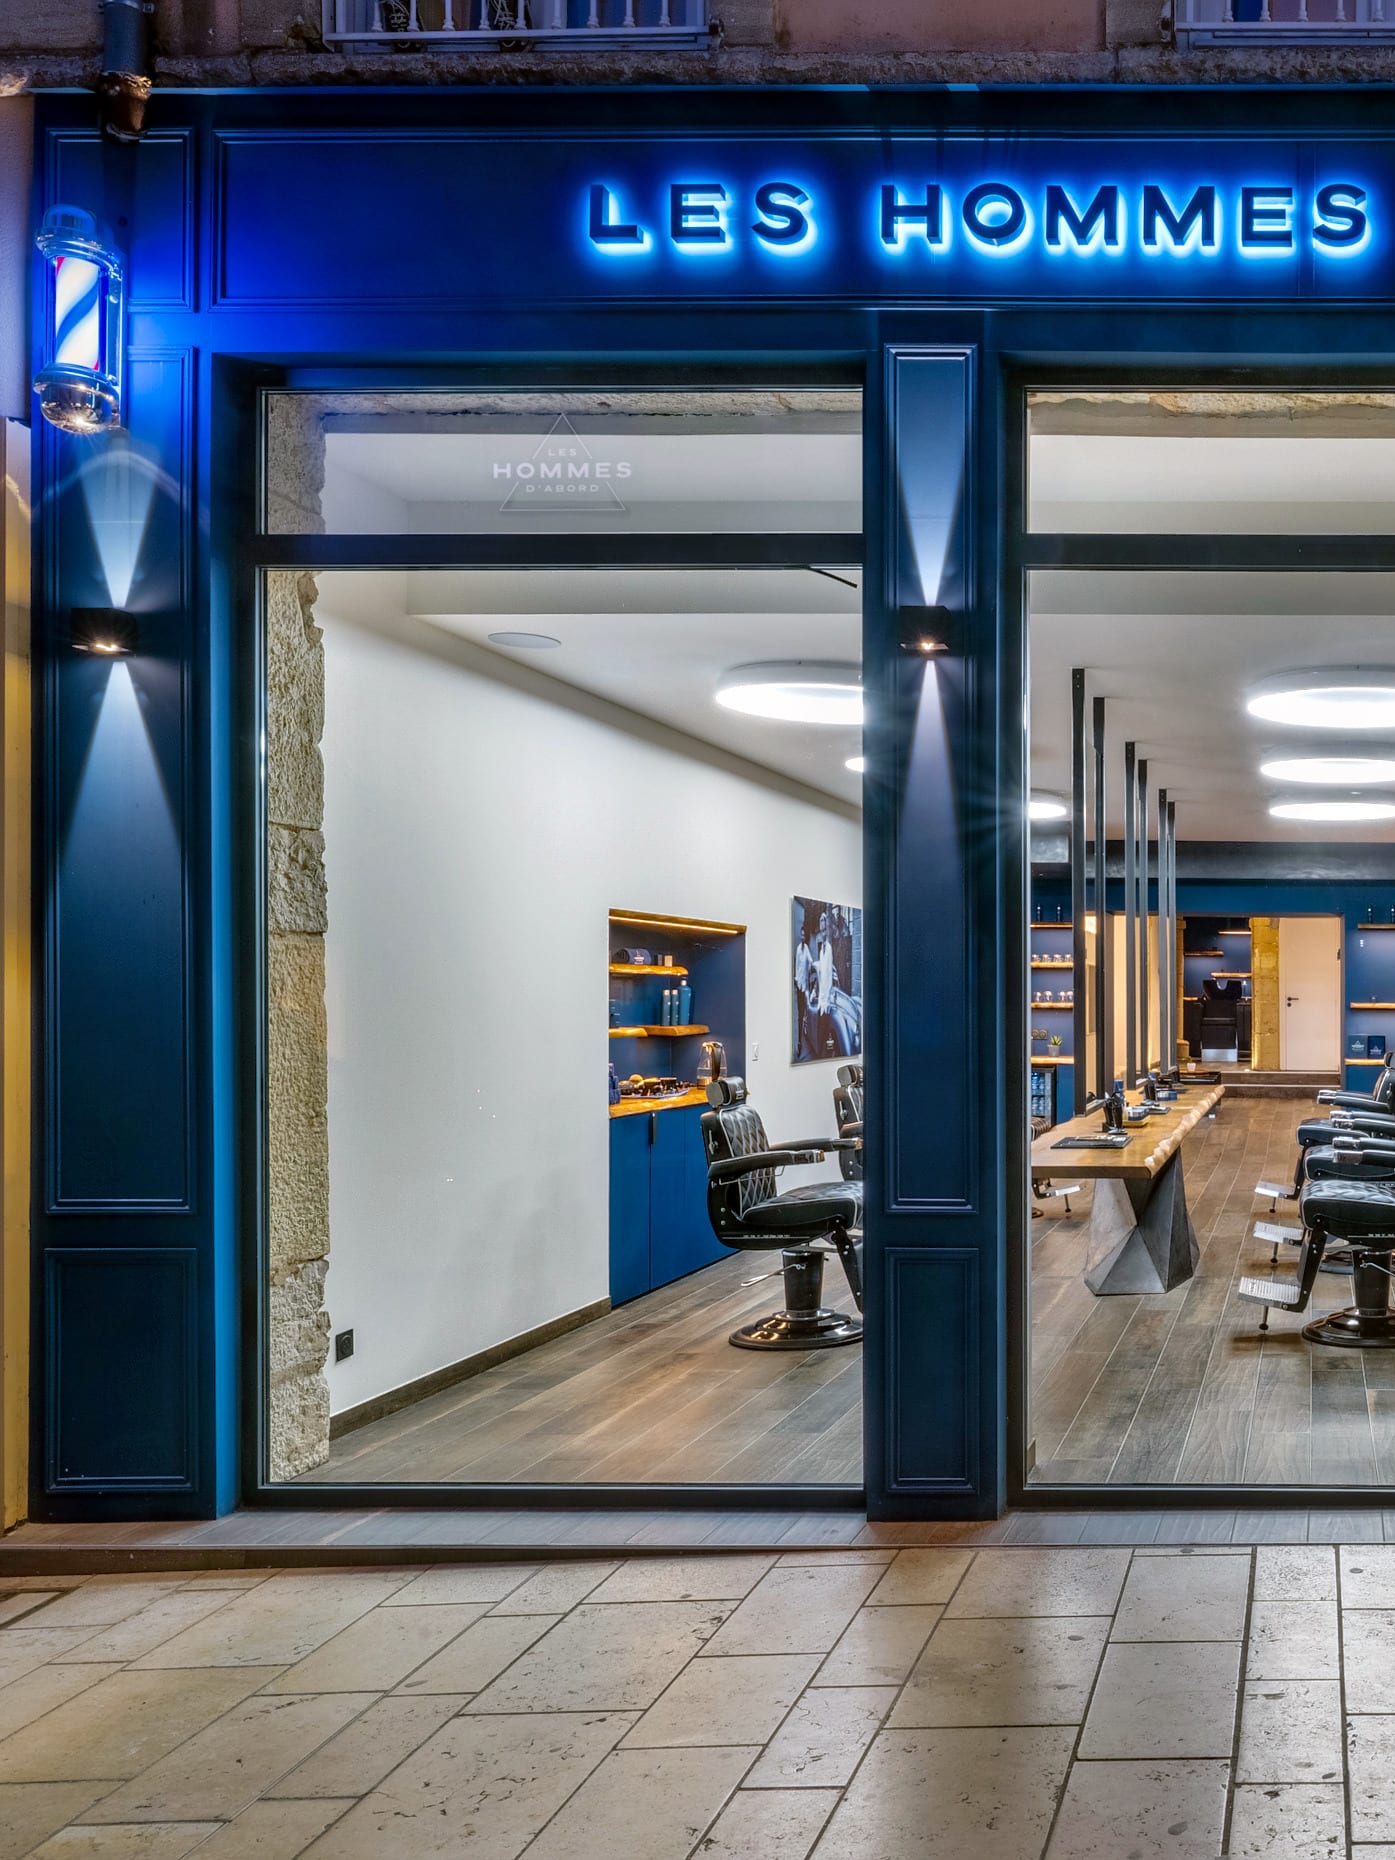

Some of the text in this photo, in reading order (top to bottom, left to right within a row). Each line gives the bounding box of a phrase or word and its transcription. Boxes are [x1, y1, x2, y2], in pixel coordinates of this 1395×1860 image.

[589, 182, 809, 245] LES
[881, 182, 1366, 247] HOMMES
[547, 448, 577, 457] LES
[493, 462, 632, 479] HOMMES
[525, 484, 600, 493] D'ABORD
